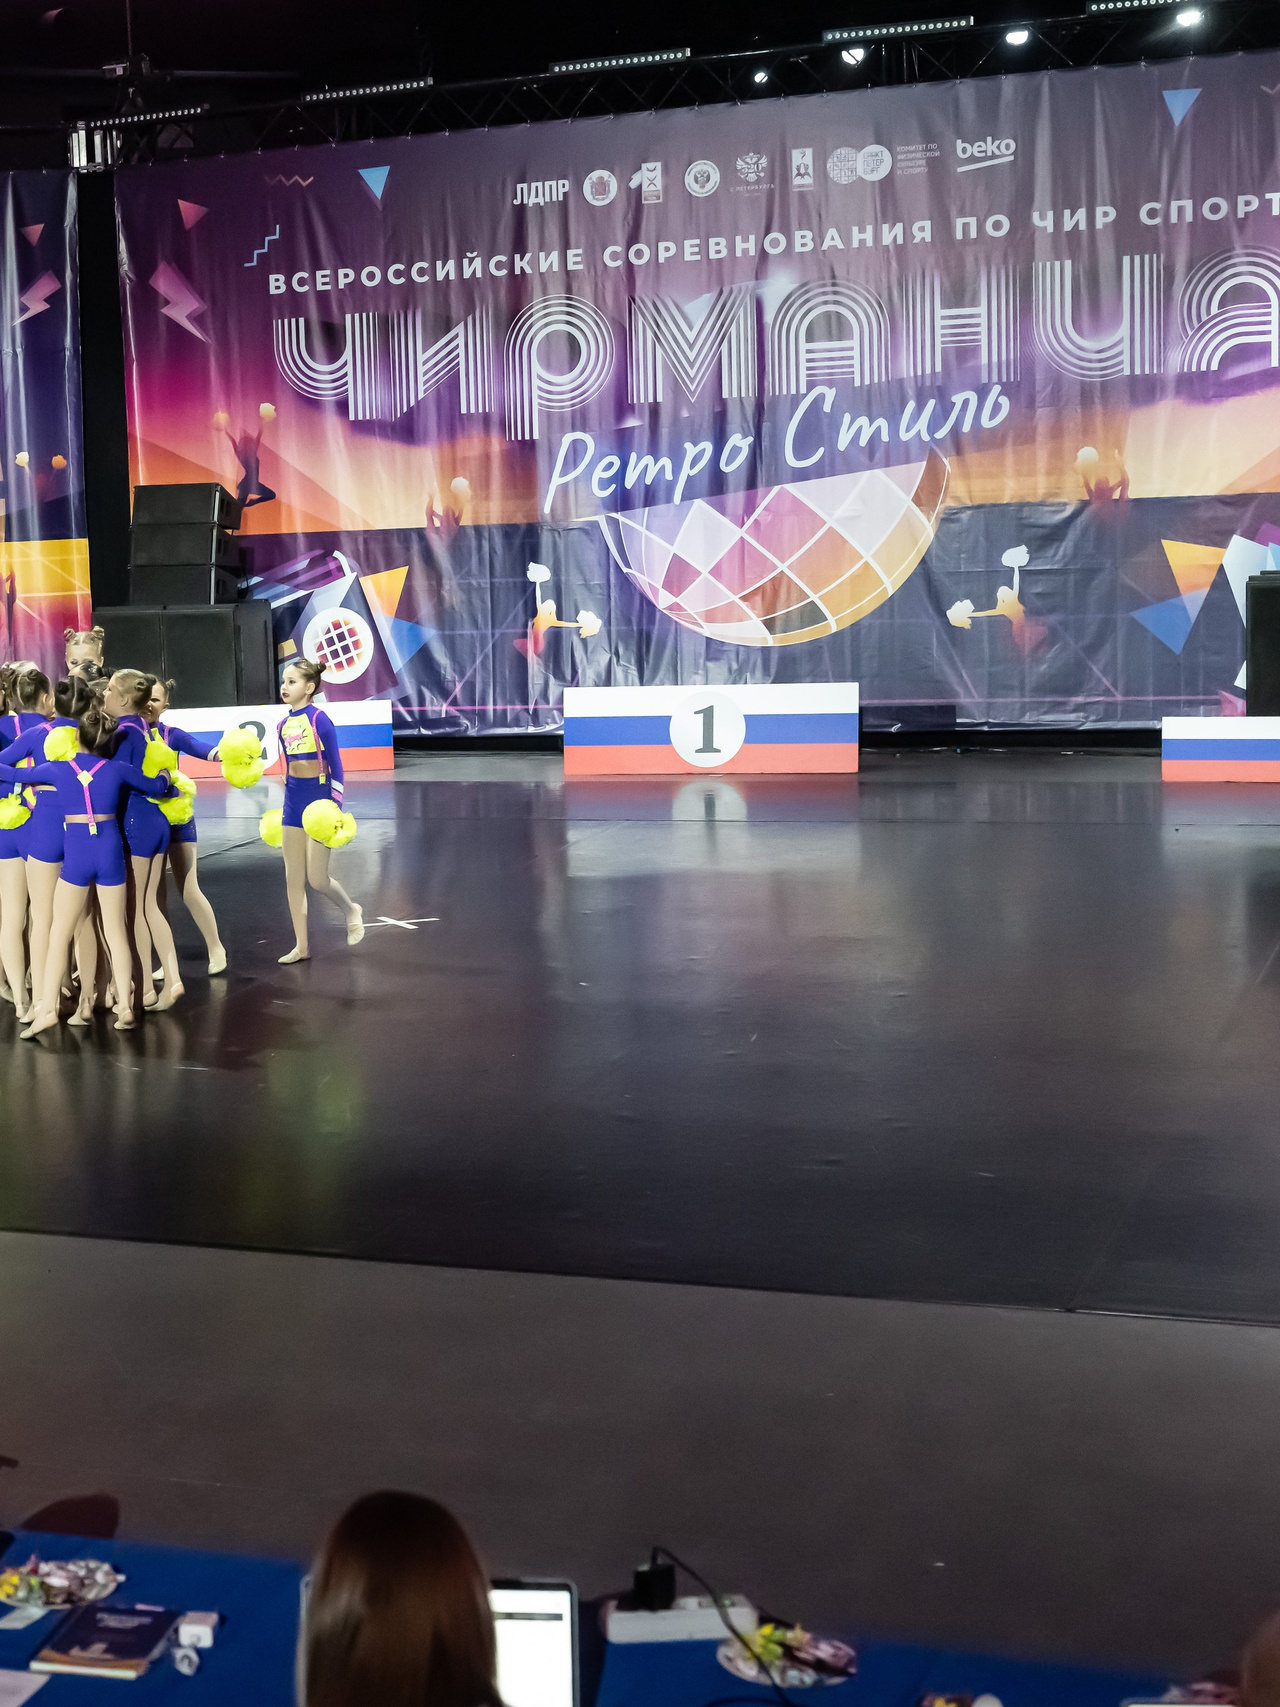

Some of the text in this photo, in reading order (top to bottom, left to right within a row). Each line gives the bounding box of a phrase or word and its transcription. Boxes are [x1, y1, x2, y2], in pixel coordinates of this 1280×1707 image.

[956, 136, 1016, 159] beko
[513, 180, 570, 206] ЛДПР
[268, 248, 584, 295] ВСЕРОССИЙСКИЕ
[602, 220, 932, 267] СОРЕВНОВАНИЯ
[955, 214, 1011, 240] ПО
[1032, 206, 1117, 234] ЧИР
[543, 384, 1011, 515] Ретро Стиль
[692, 704, 722, 754] 1
